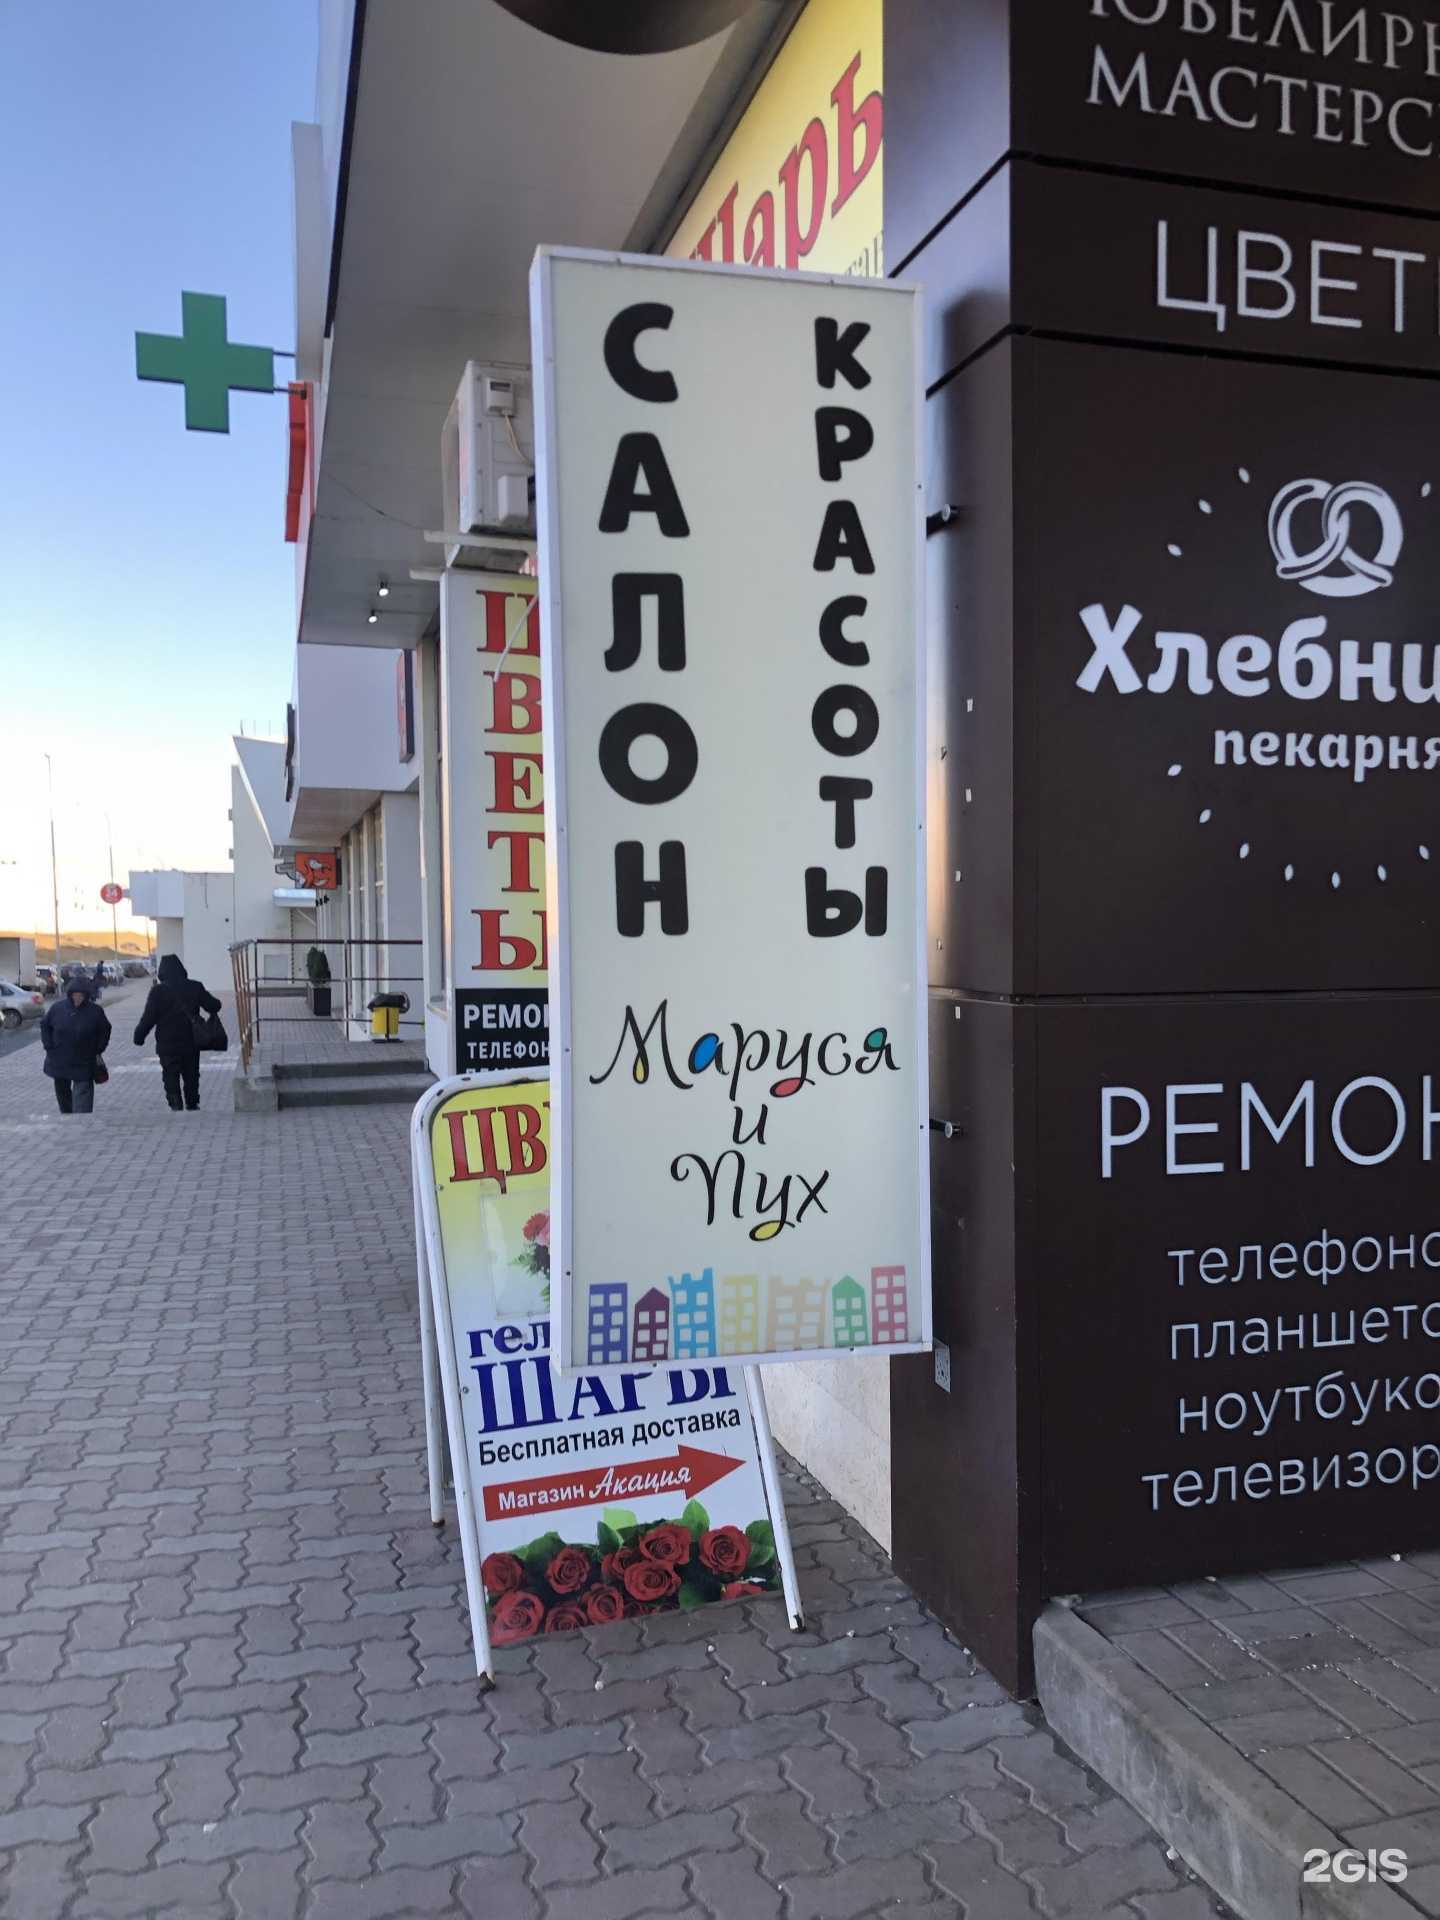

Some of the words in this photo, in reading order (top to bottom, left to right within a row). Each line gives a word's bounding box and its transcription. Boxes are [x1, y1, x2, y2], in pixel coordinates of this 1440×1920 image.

[1085, 44, 1440, 156] МАСТЕРС
[1157, 219, 1440, 334] ЦВЕТ
[599, 302, 698, 938] САЛОН
[804, 317, 888, 938] КРАСОТЫ
[589, 999, 901, 1101] Маруся
[442, 1101, 550, 1194] ЦВ
[732, 1103, 768, 1145] и
[1101, 1075, 1440, 1178] РЕМО
[670, 1150, 829, 1242] Пух
[478, 1427, 625, 1466] Бесплатная
[632, 1407, 741, 1446] доставка
[1179, 1371, 1440, 1437] ноутбуко
[498, 1483, 585, 1511] Магазин
[588, 1465, 693, 1500] Акация
[1141, 1443, 1440, 1511] телевизор
